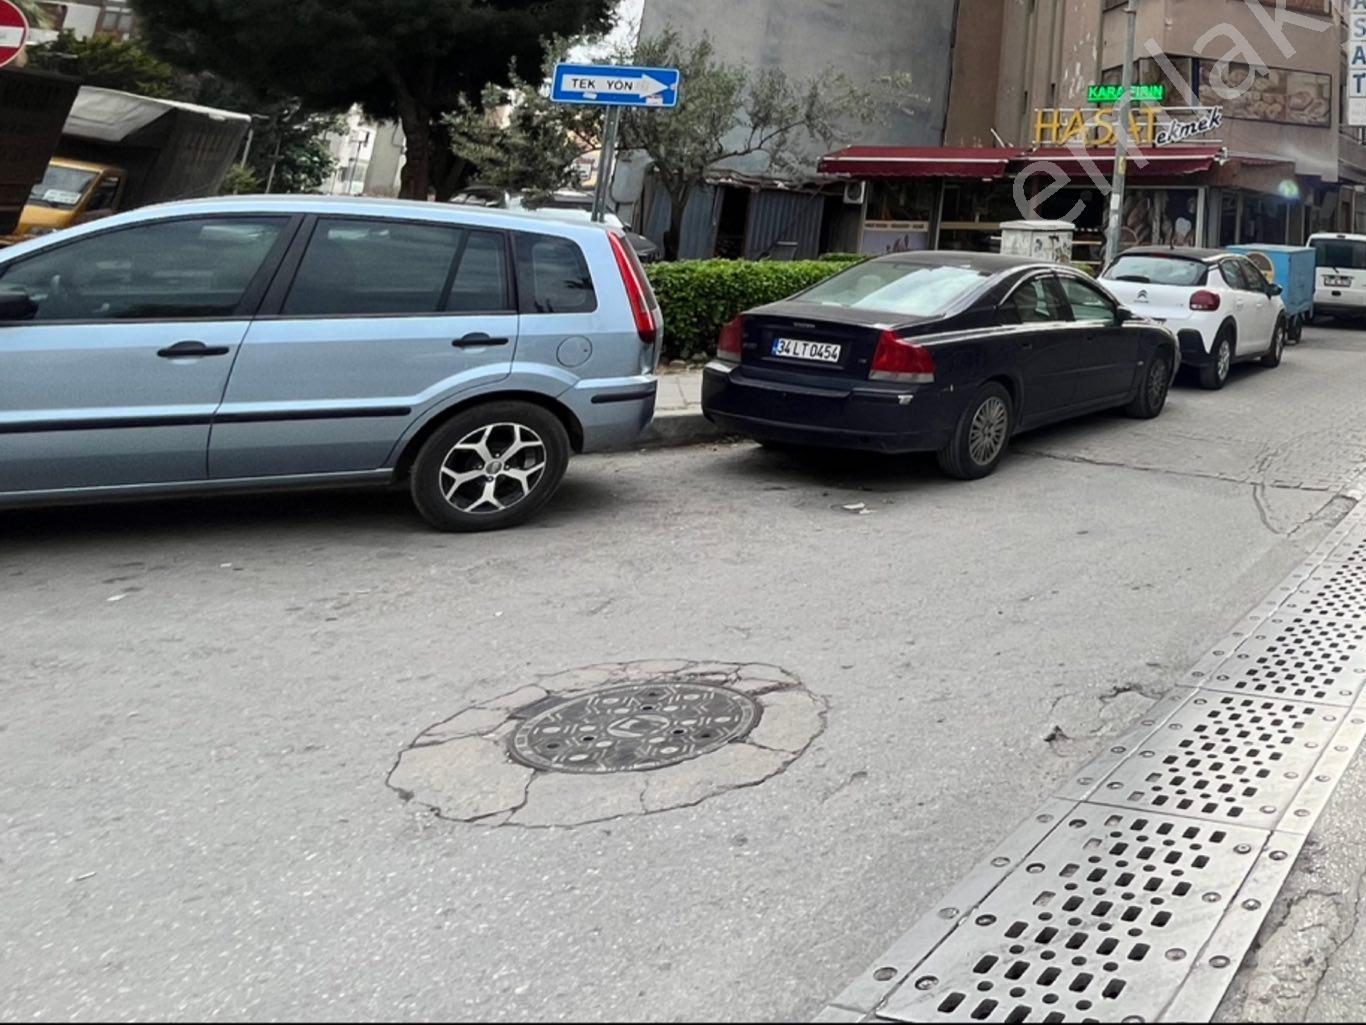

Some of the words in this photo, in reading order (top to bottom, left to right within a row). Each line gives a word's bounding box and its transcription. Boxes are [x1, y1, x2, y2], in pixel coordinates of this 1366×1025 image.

[572, 78, 596, 89] TEK
[607, 77, 633, 90] YÖN
[1156, 106, 1223, 145] ekmek
[778, 340, 791, 352] 34
[793, 341, 808, 356] LT
[810, 344, 838, 360] 0454
